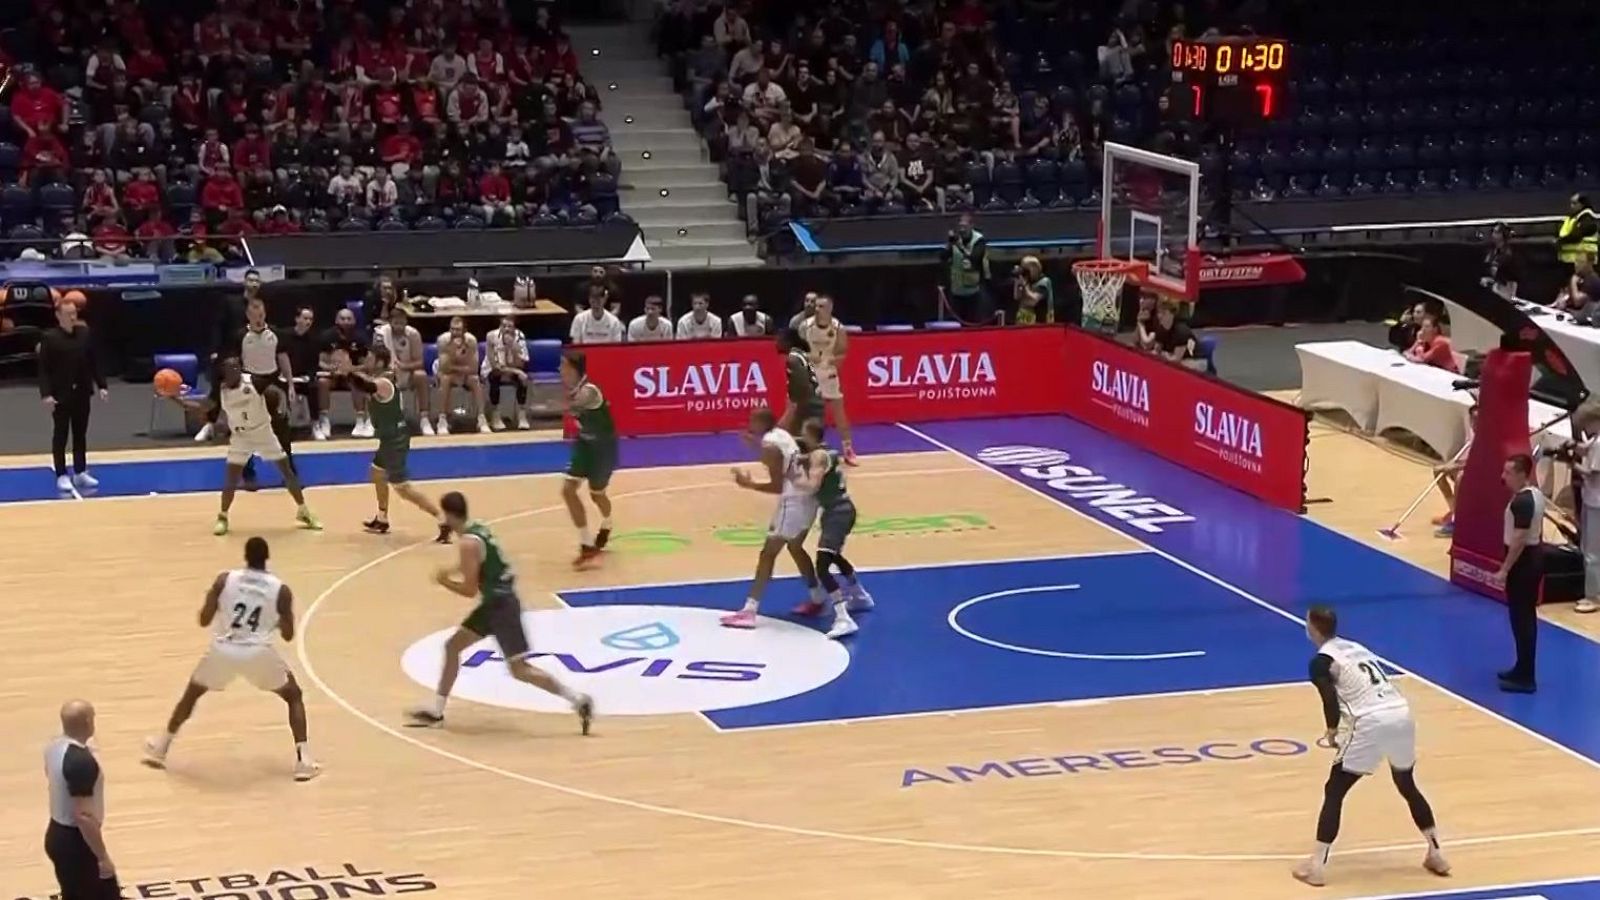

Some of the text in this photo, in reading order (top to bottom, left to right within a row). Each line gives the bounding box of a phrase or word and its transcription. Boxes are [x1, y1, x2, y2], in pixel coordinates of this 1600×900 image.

[1255, 84, 1273, 116] 7
[633, 361, 768, 399] SLAVIA
[867, 351, 997, 387] SLAVIA
[1092, 360, 1150, 412] SLAVIA
[1194, 401, 1263, 458] SLAVIA
[1020, 464, 1197, 533] SUNEL
[231, 602, 262, 633] 24
[901, 738, 1308, 788] AMERESCO
[119, 863, 384, 899] ETBALL
